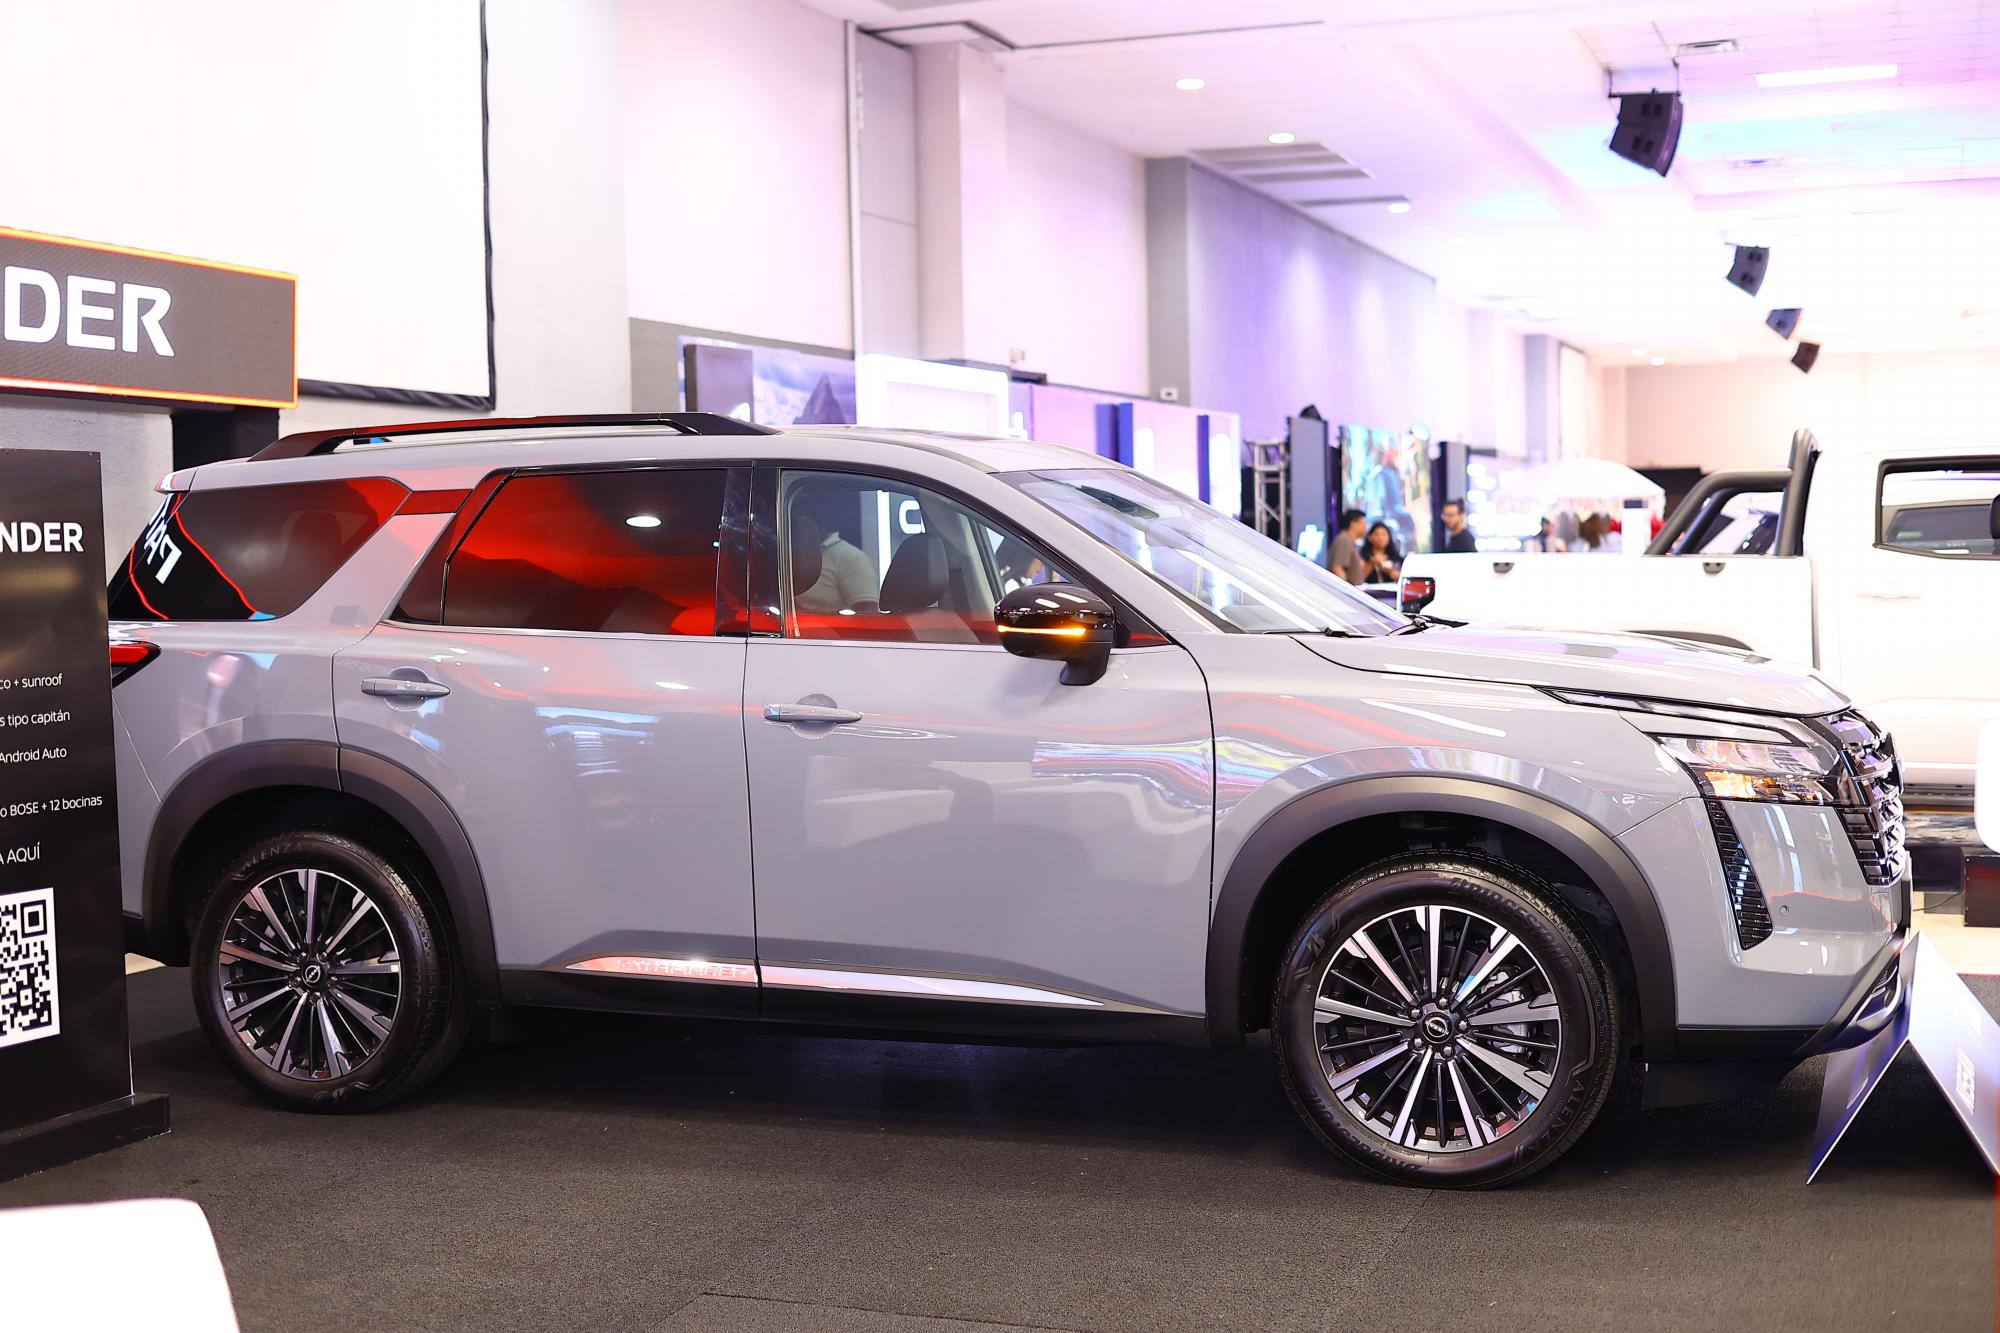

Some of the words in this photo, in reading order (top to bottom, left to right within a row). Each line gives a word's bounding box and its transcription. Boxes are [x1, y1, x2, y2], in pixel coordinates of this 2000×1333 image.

[4, 265, 175, 357] DER
[0, 521, 84, 553] NDER
[21, 673, 63, 689] sunroof
[7, 714, 29, 729] tipo
[31, 708, 71, 726] capitán
[0, 747, 40, 763] Android
[42, 747, 67, 759] Auto
[10, 801, 40, 817] BOSE
[49, 799, 60, 811] 12
[62, 796, 103, 810] bocinas
[7, 841, 41, 864] AQUÍ
[1449, 876, 1575, 971] BRIDGESTONE
[1302, 1086, 1422, 1175] BRIDGESTONE
